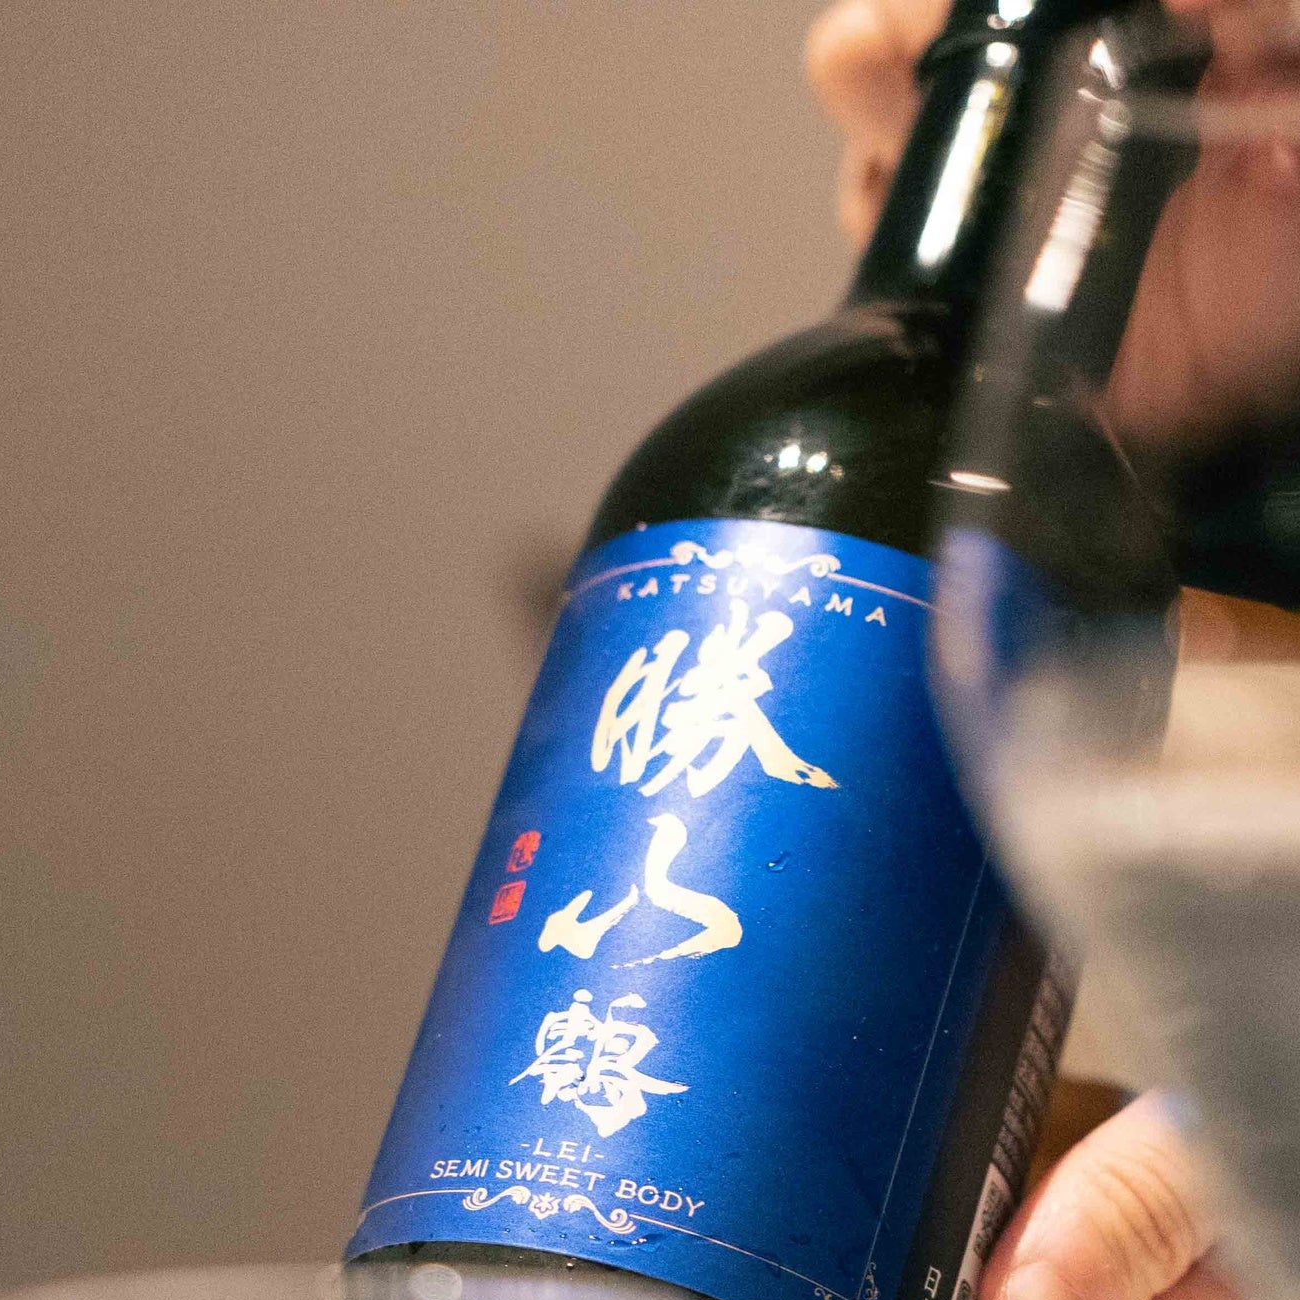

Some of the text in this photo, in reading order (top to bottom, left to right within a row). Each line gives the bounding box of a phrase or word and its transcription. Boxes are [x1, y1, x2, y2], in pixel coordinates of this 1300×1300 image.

[617, 574, 887, 627] KATSUYAMA
[430, 1159, 705, 1217] SEMI SWEET BODY
